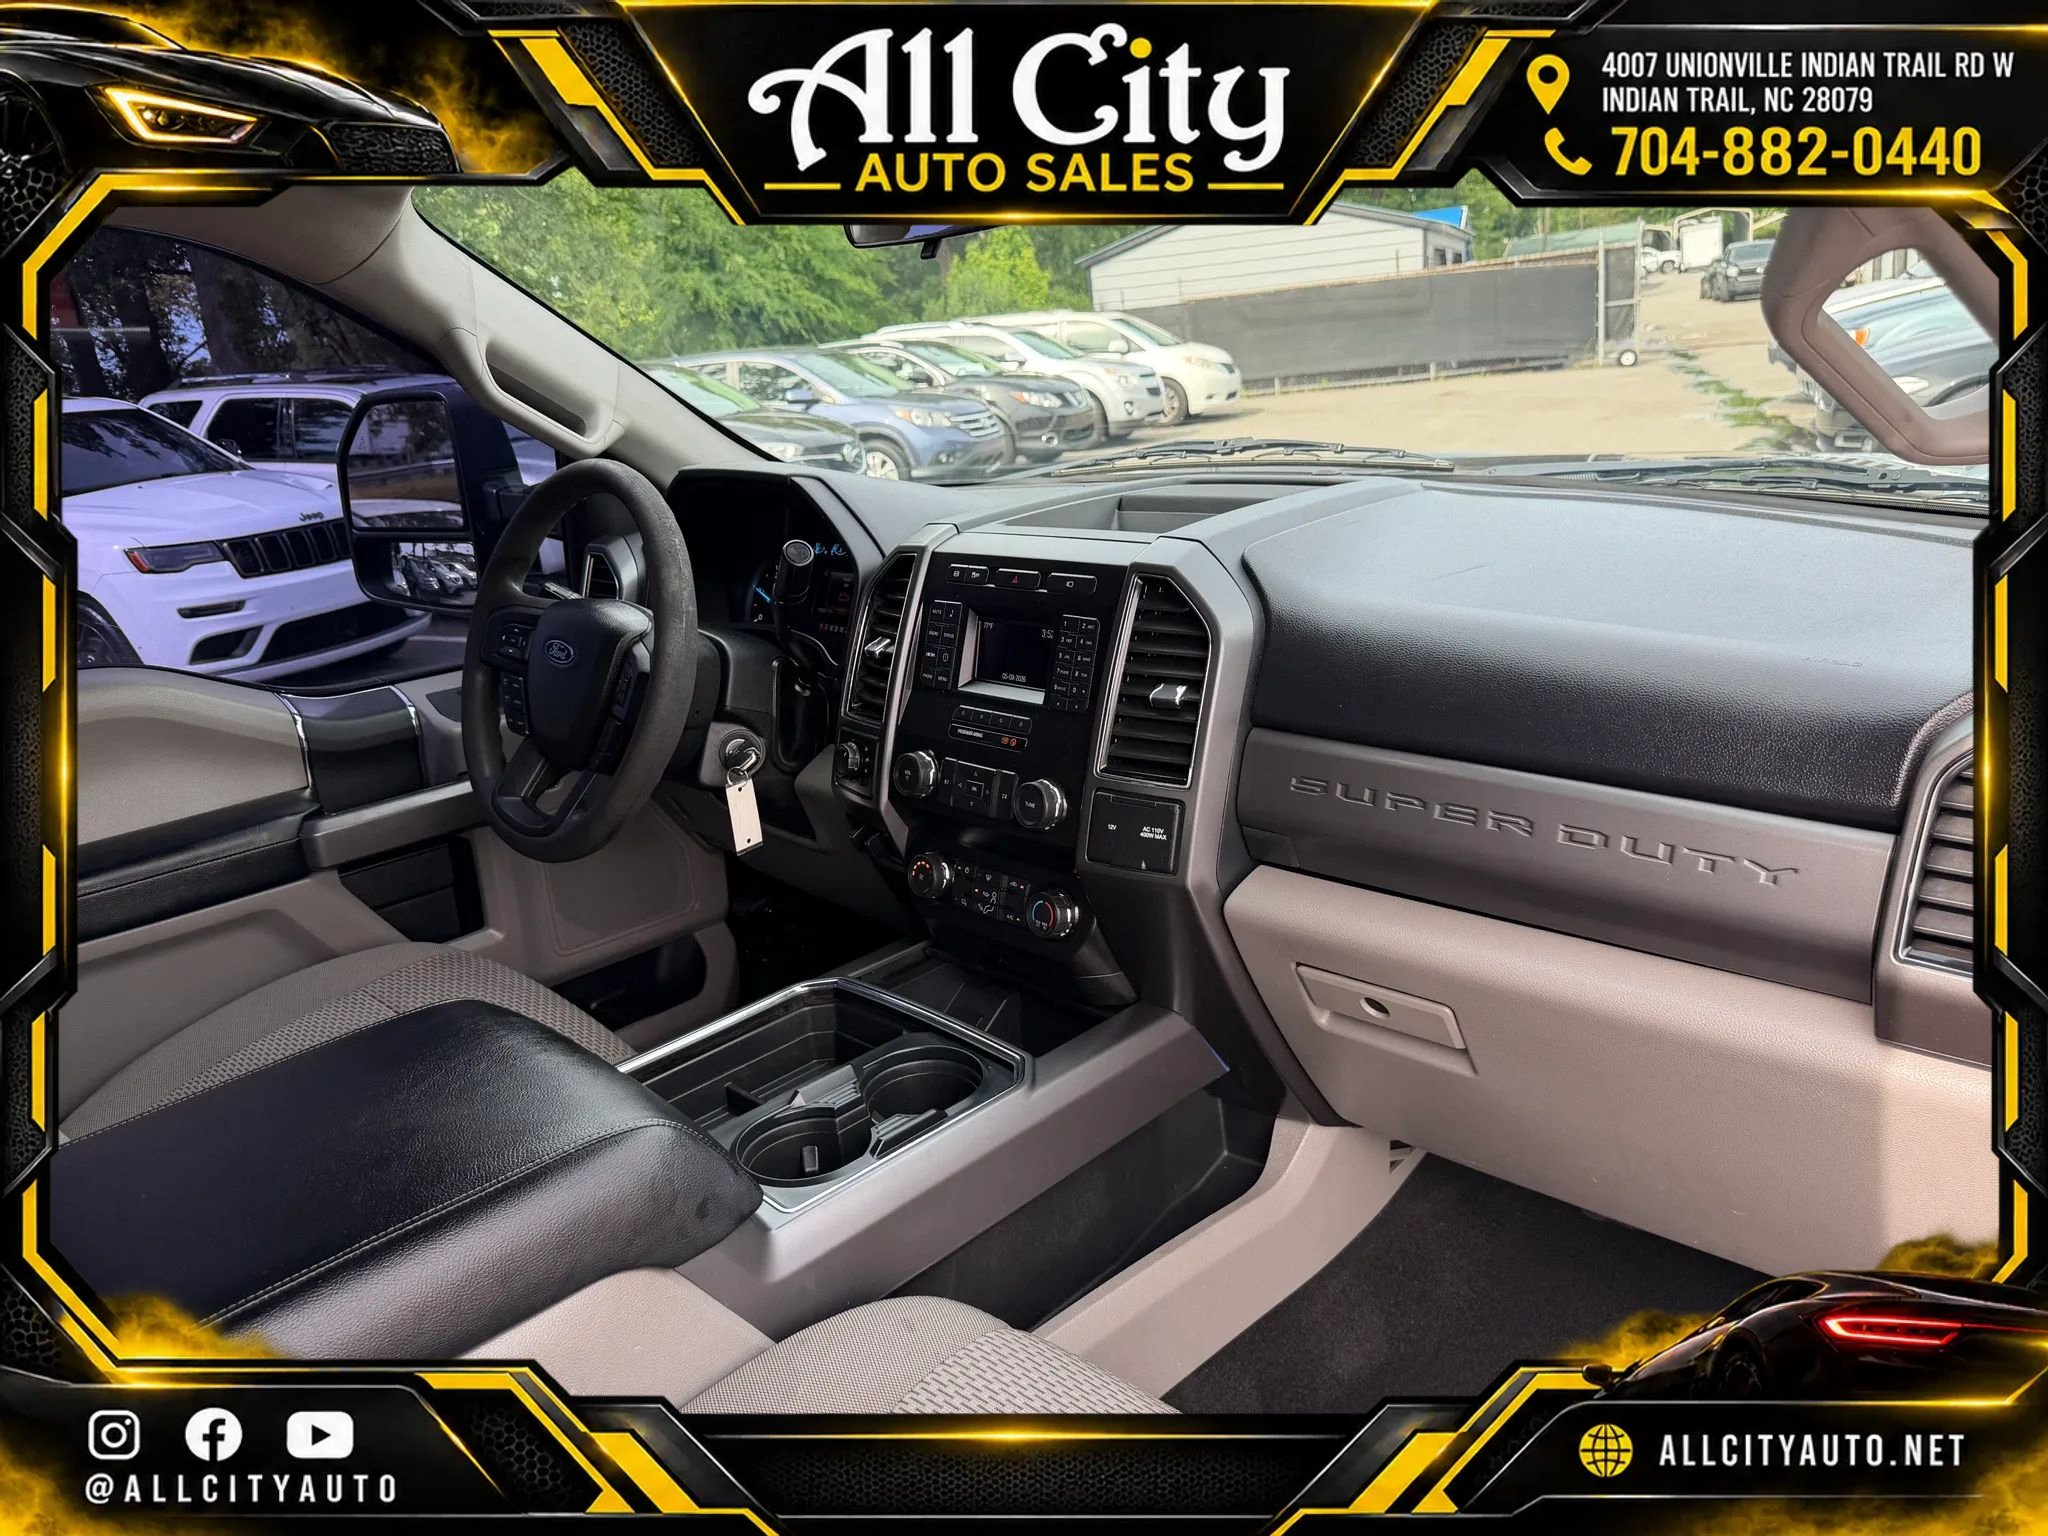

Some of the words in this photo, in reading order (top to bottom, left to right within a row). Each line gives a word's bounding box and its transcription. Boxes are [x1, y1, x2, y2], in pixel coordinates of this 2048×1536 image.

[299, 511, 324, 522] Jeep
[1024, 801, 1036, 809] TUNE
[1107, 823, 1117, 831] 12V
[1290, 775, 1534, 837] SUPER
[1557, 823, 1798, 887] DUTY
